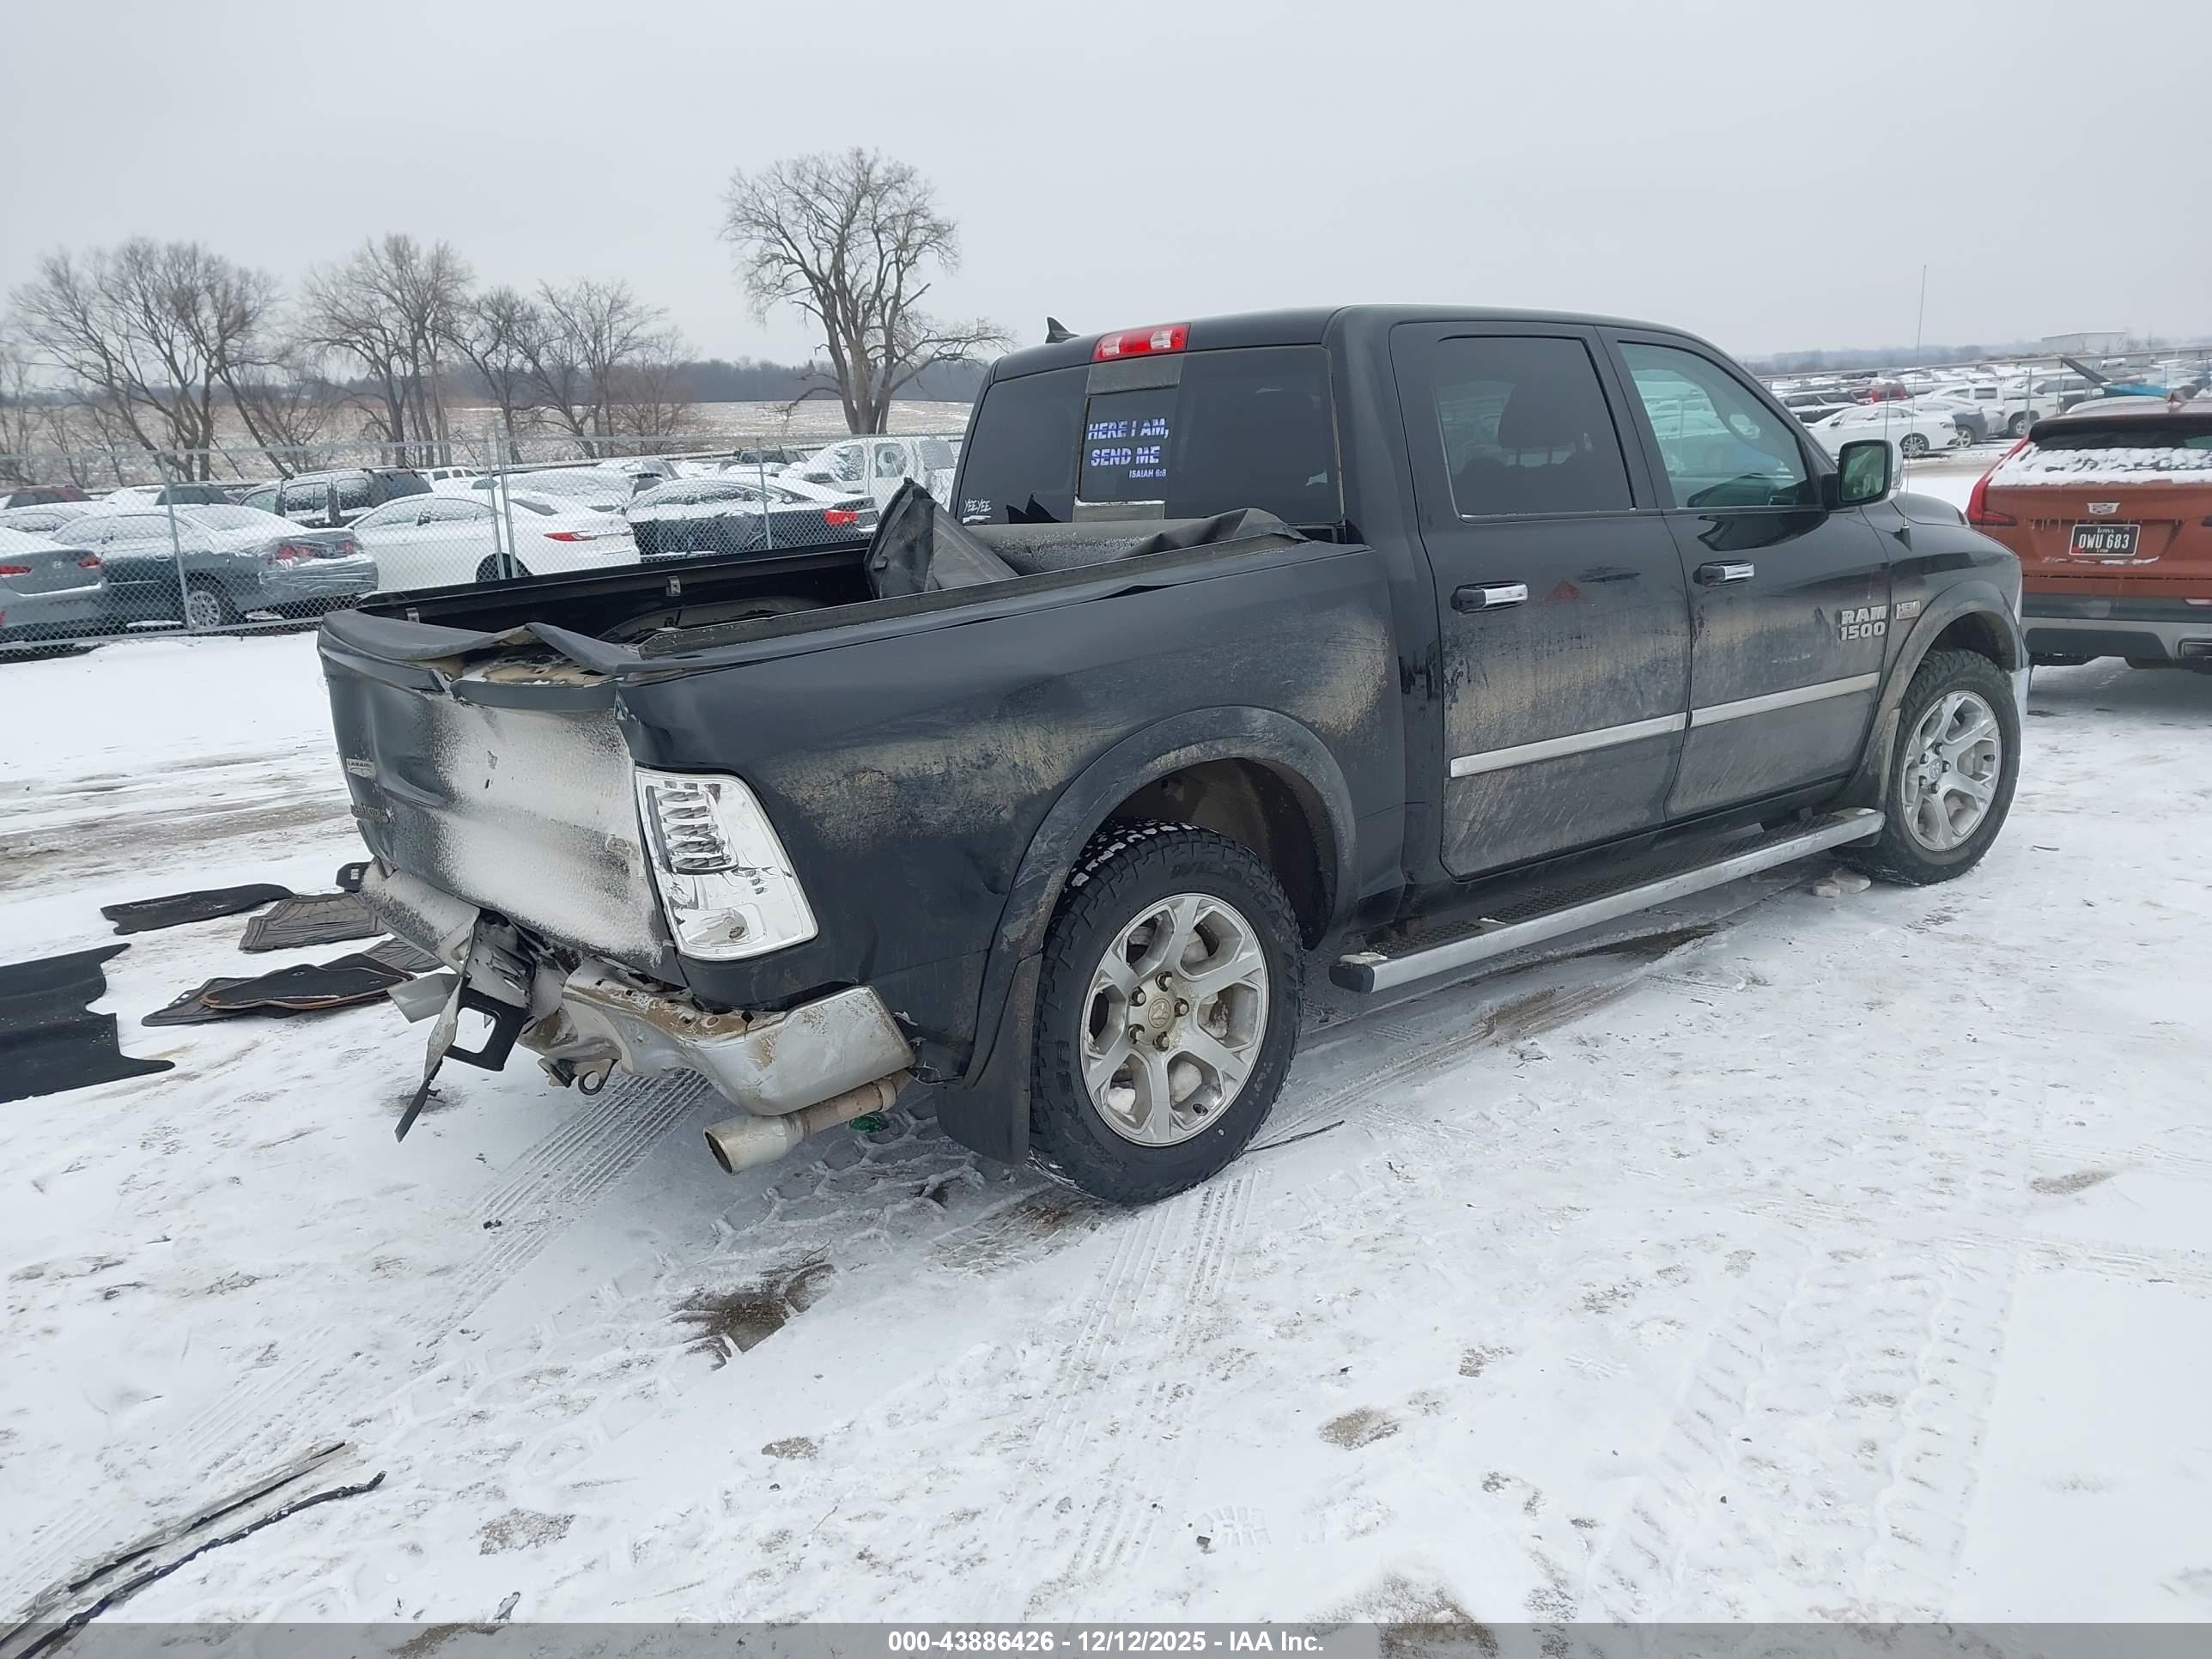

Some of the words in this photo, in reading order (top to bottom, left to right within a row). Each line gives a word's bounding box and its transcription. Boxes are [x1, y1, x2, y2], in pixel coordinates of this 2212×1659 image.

[1087, 421, 1127, 441] HERE
[1131, 420, 1137, 437] I
[1140, 418, 1170, 439] AM,
[1091, 447, 1132, 466] SEND
[1135, 446, 1161, 465] ME
[1129, 469, 1154, 478] ISAIAH
[1155, 468, 1167, 477] 6:8
[2078, 533, 2104, 550] OWU
[2106, 533, 2130, 550] 683
[1841, 605, 1887, 624] RAM
[1840, 621, 1886, 641] 1500
